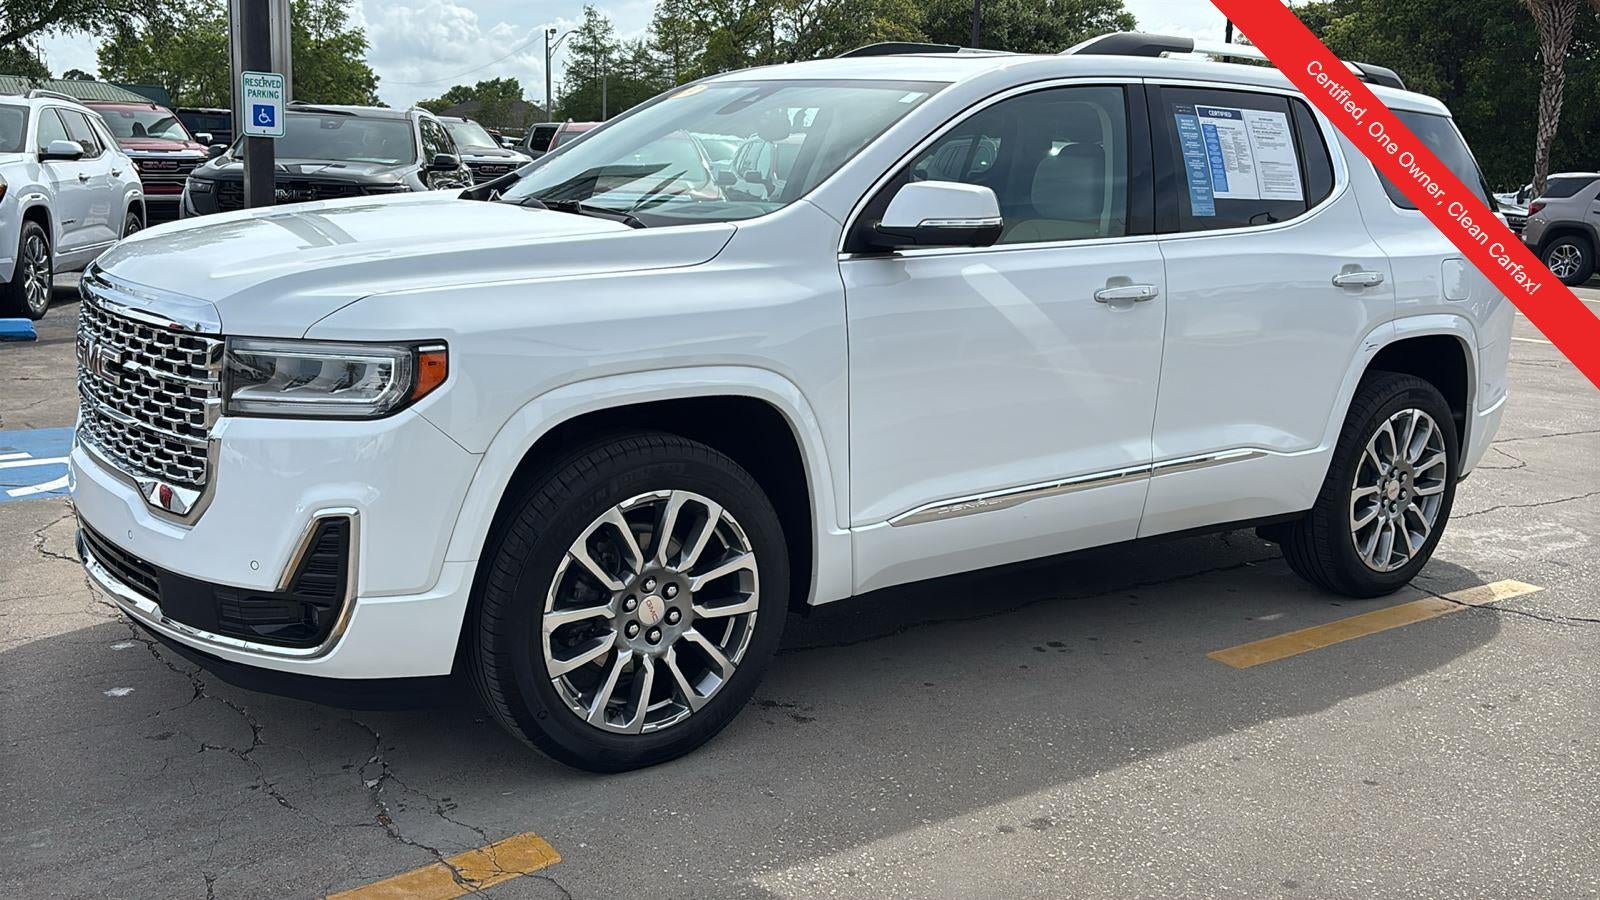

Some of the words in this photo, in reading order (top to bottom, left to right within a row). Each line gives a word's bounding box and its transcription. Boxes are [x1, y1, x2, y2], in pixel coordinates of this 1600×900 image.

[245, 78, 282, 89] RESERVED
[247, 89, 280, 99] PARKING
[1208, 110, 1233, 118] CERTIFIED
[480, 165, 508, 173] GMC
[76, 330, 121, 386] GMC
[645, 599, 660, 624] GMC
